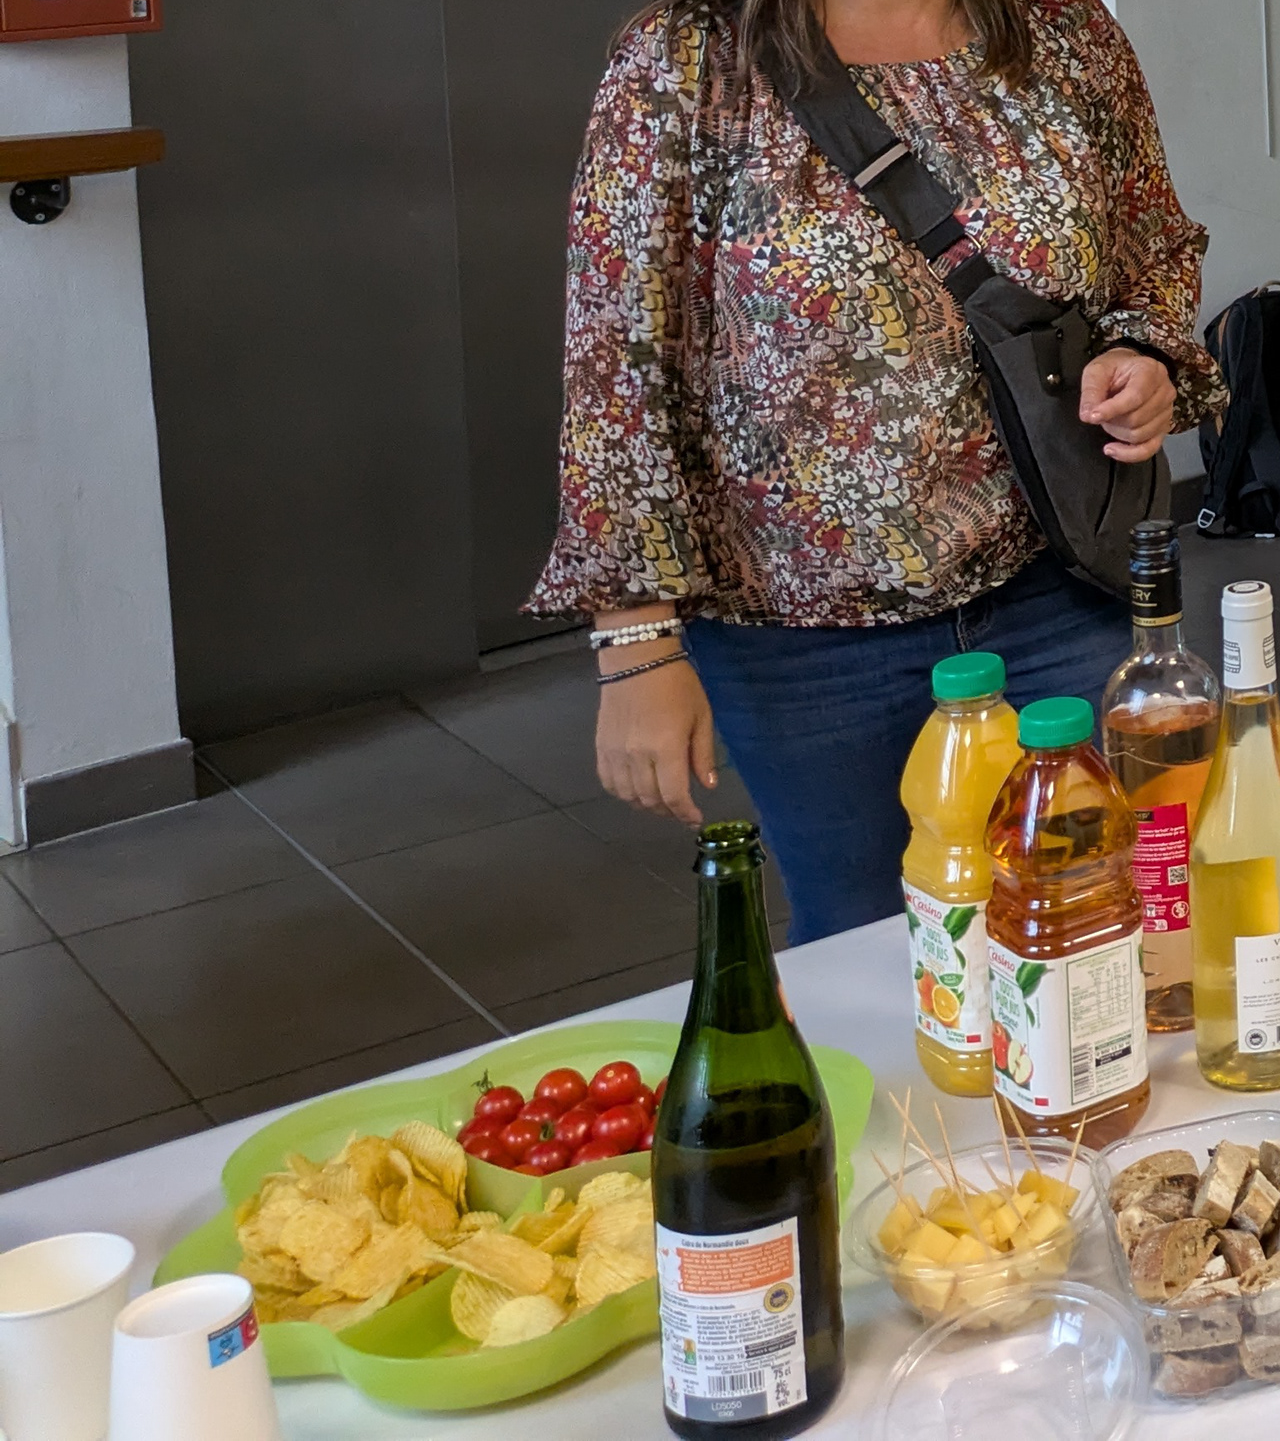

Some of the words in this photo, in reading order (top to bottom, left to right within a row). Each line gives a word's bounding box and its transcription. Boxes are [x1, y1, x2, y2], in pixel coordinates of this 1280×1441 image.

[911, 895, 942, 920] Casino
[922, 937, 936, 956] PUR
[936, 945, 949, 962] JUS
[987, 946, 1015, 973] Casino
[703, 1240, 733, 1248] Normandie
